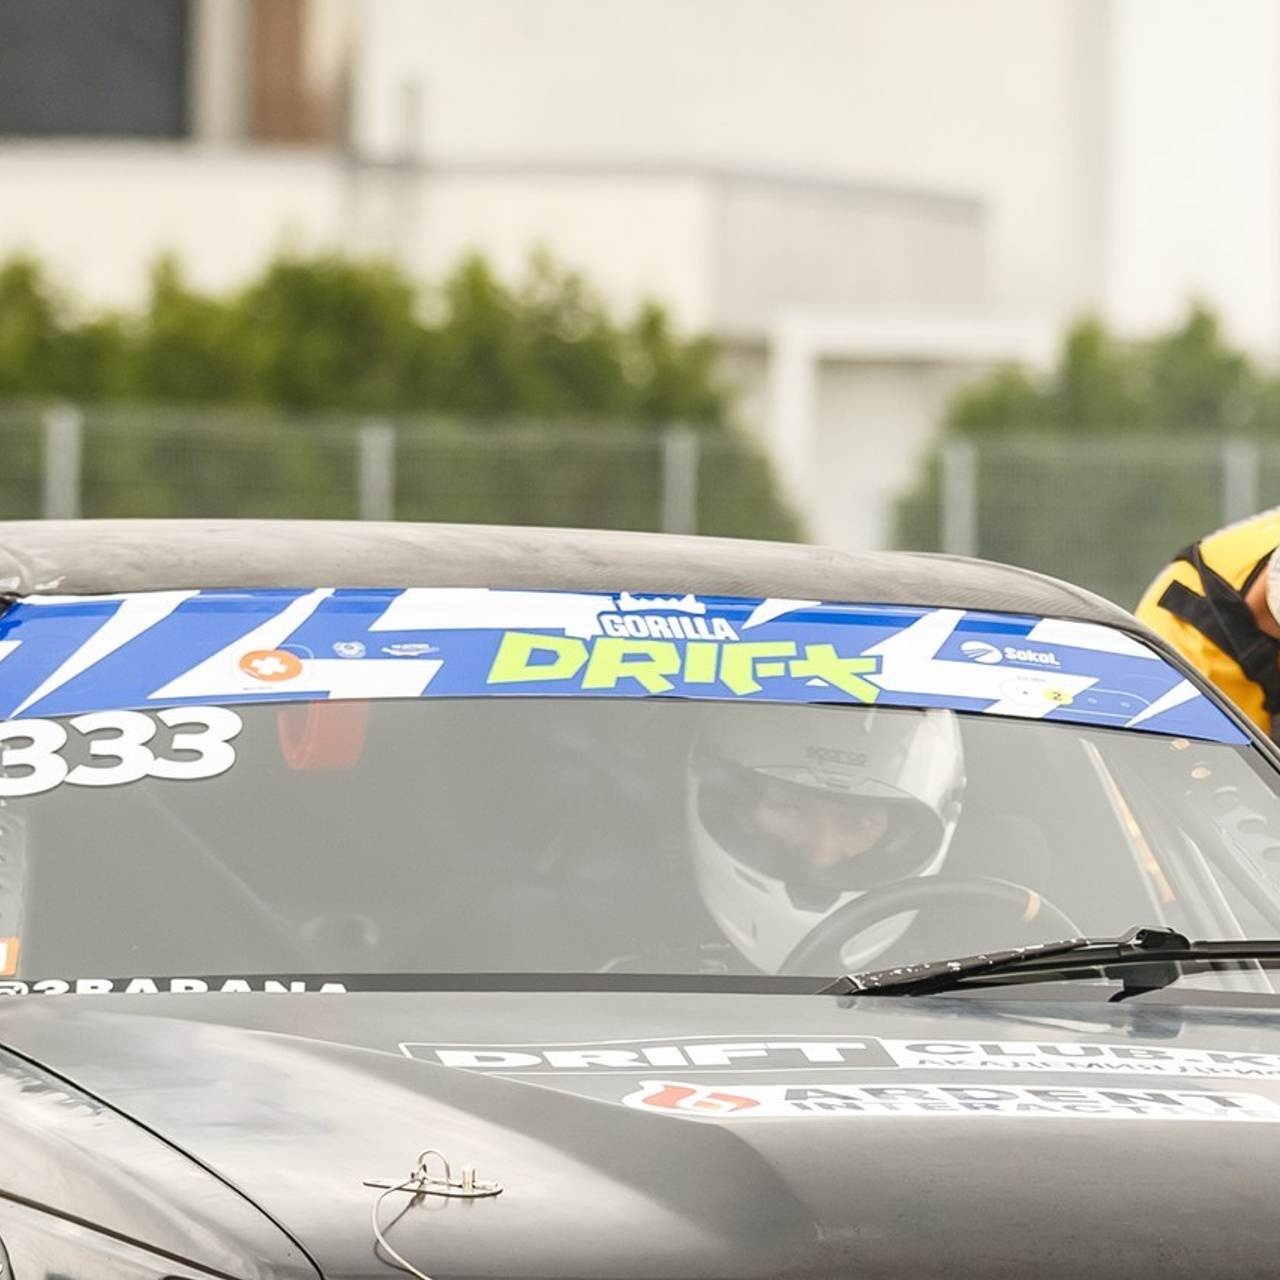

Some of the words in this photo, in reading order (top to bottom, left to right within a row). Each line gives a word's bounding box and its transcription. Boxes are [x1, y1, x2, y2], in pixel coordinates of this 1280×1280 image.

[601, 613, 740, 641] GORILLA
[486, 630, 881, 704] DRIFT
[0, 705, 243, 797] 333
[434, 1041, 867, 1068] DRIFT
[784, 1087, 1248, 1109] ARDENT
